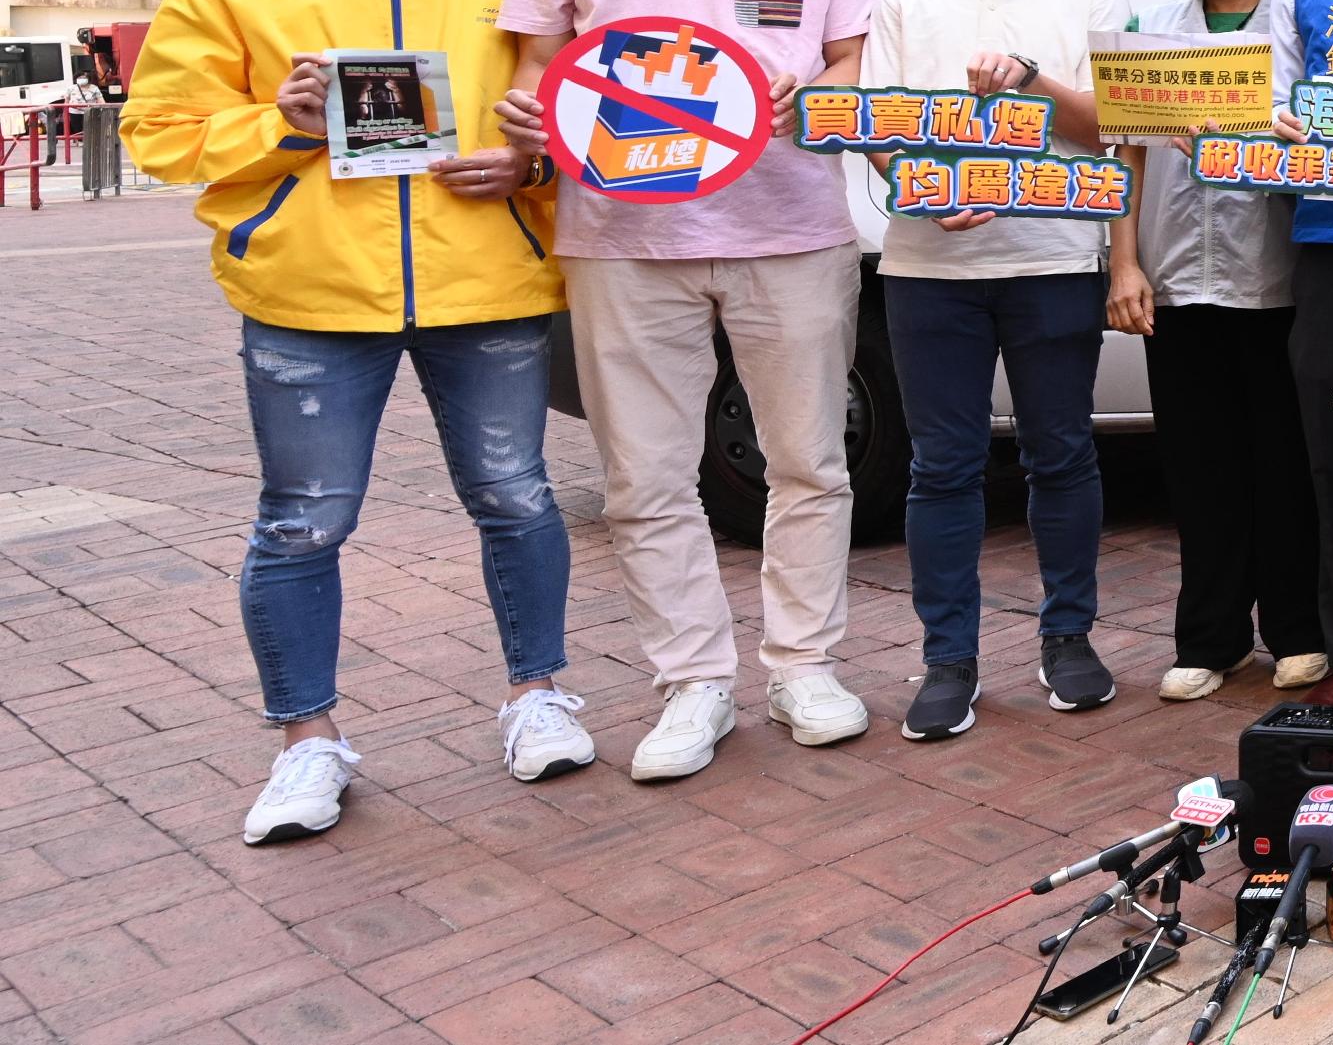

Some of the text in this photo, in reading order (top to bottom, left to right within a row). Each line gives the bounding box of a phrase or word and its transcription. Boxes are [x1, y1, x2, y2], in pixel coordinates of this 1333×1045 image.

[1098, 67, 1267, 86] 嚴禁分發吸煙產品廣告
[1109, 86, 1259, 104] 最高罰款港幣五萬元
[804, 94, 1047, 147] 買賣私煙
[624, 138, 700, 171] 私煙
[896, 160, 1126, 211] 均屬違法
